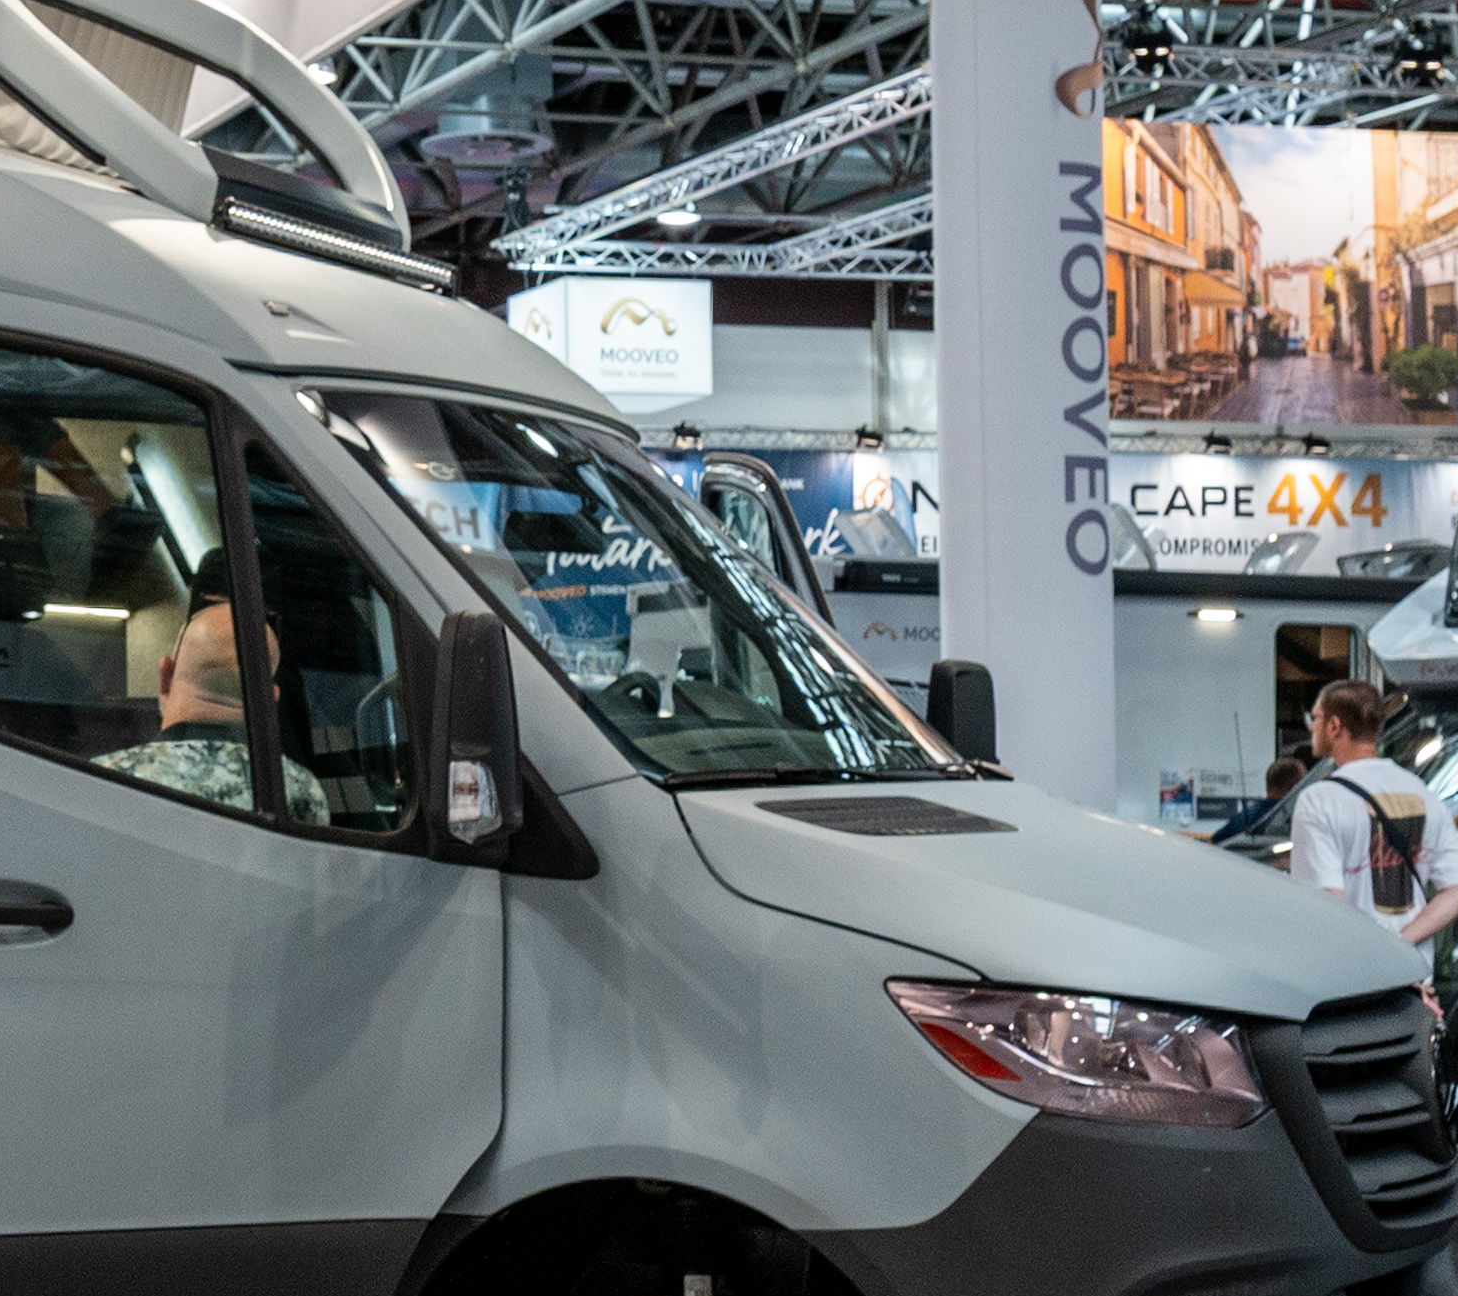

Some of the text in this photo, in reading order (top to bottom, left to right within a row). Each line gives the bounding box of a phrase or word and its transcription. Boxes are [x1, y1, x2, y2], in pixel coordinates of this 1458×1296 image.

[600, 347, 680, 365] MOOVEO
[1058, 161, 1111, 577] MOOVEO
[1129, 471, 1389, 528] CAPE 4X4
